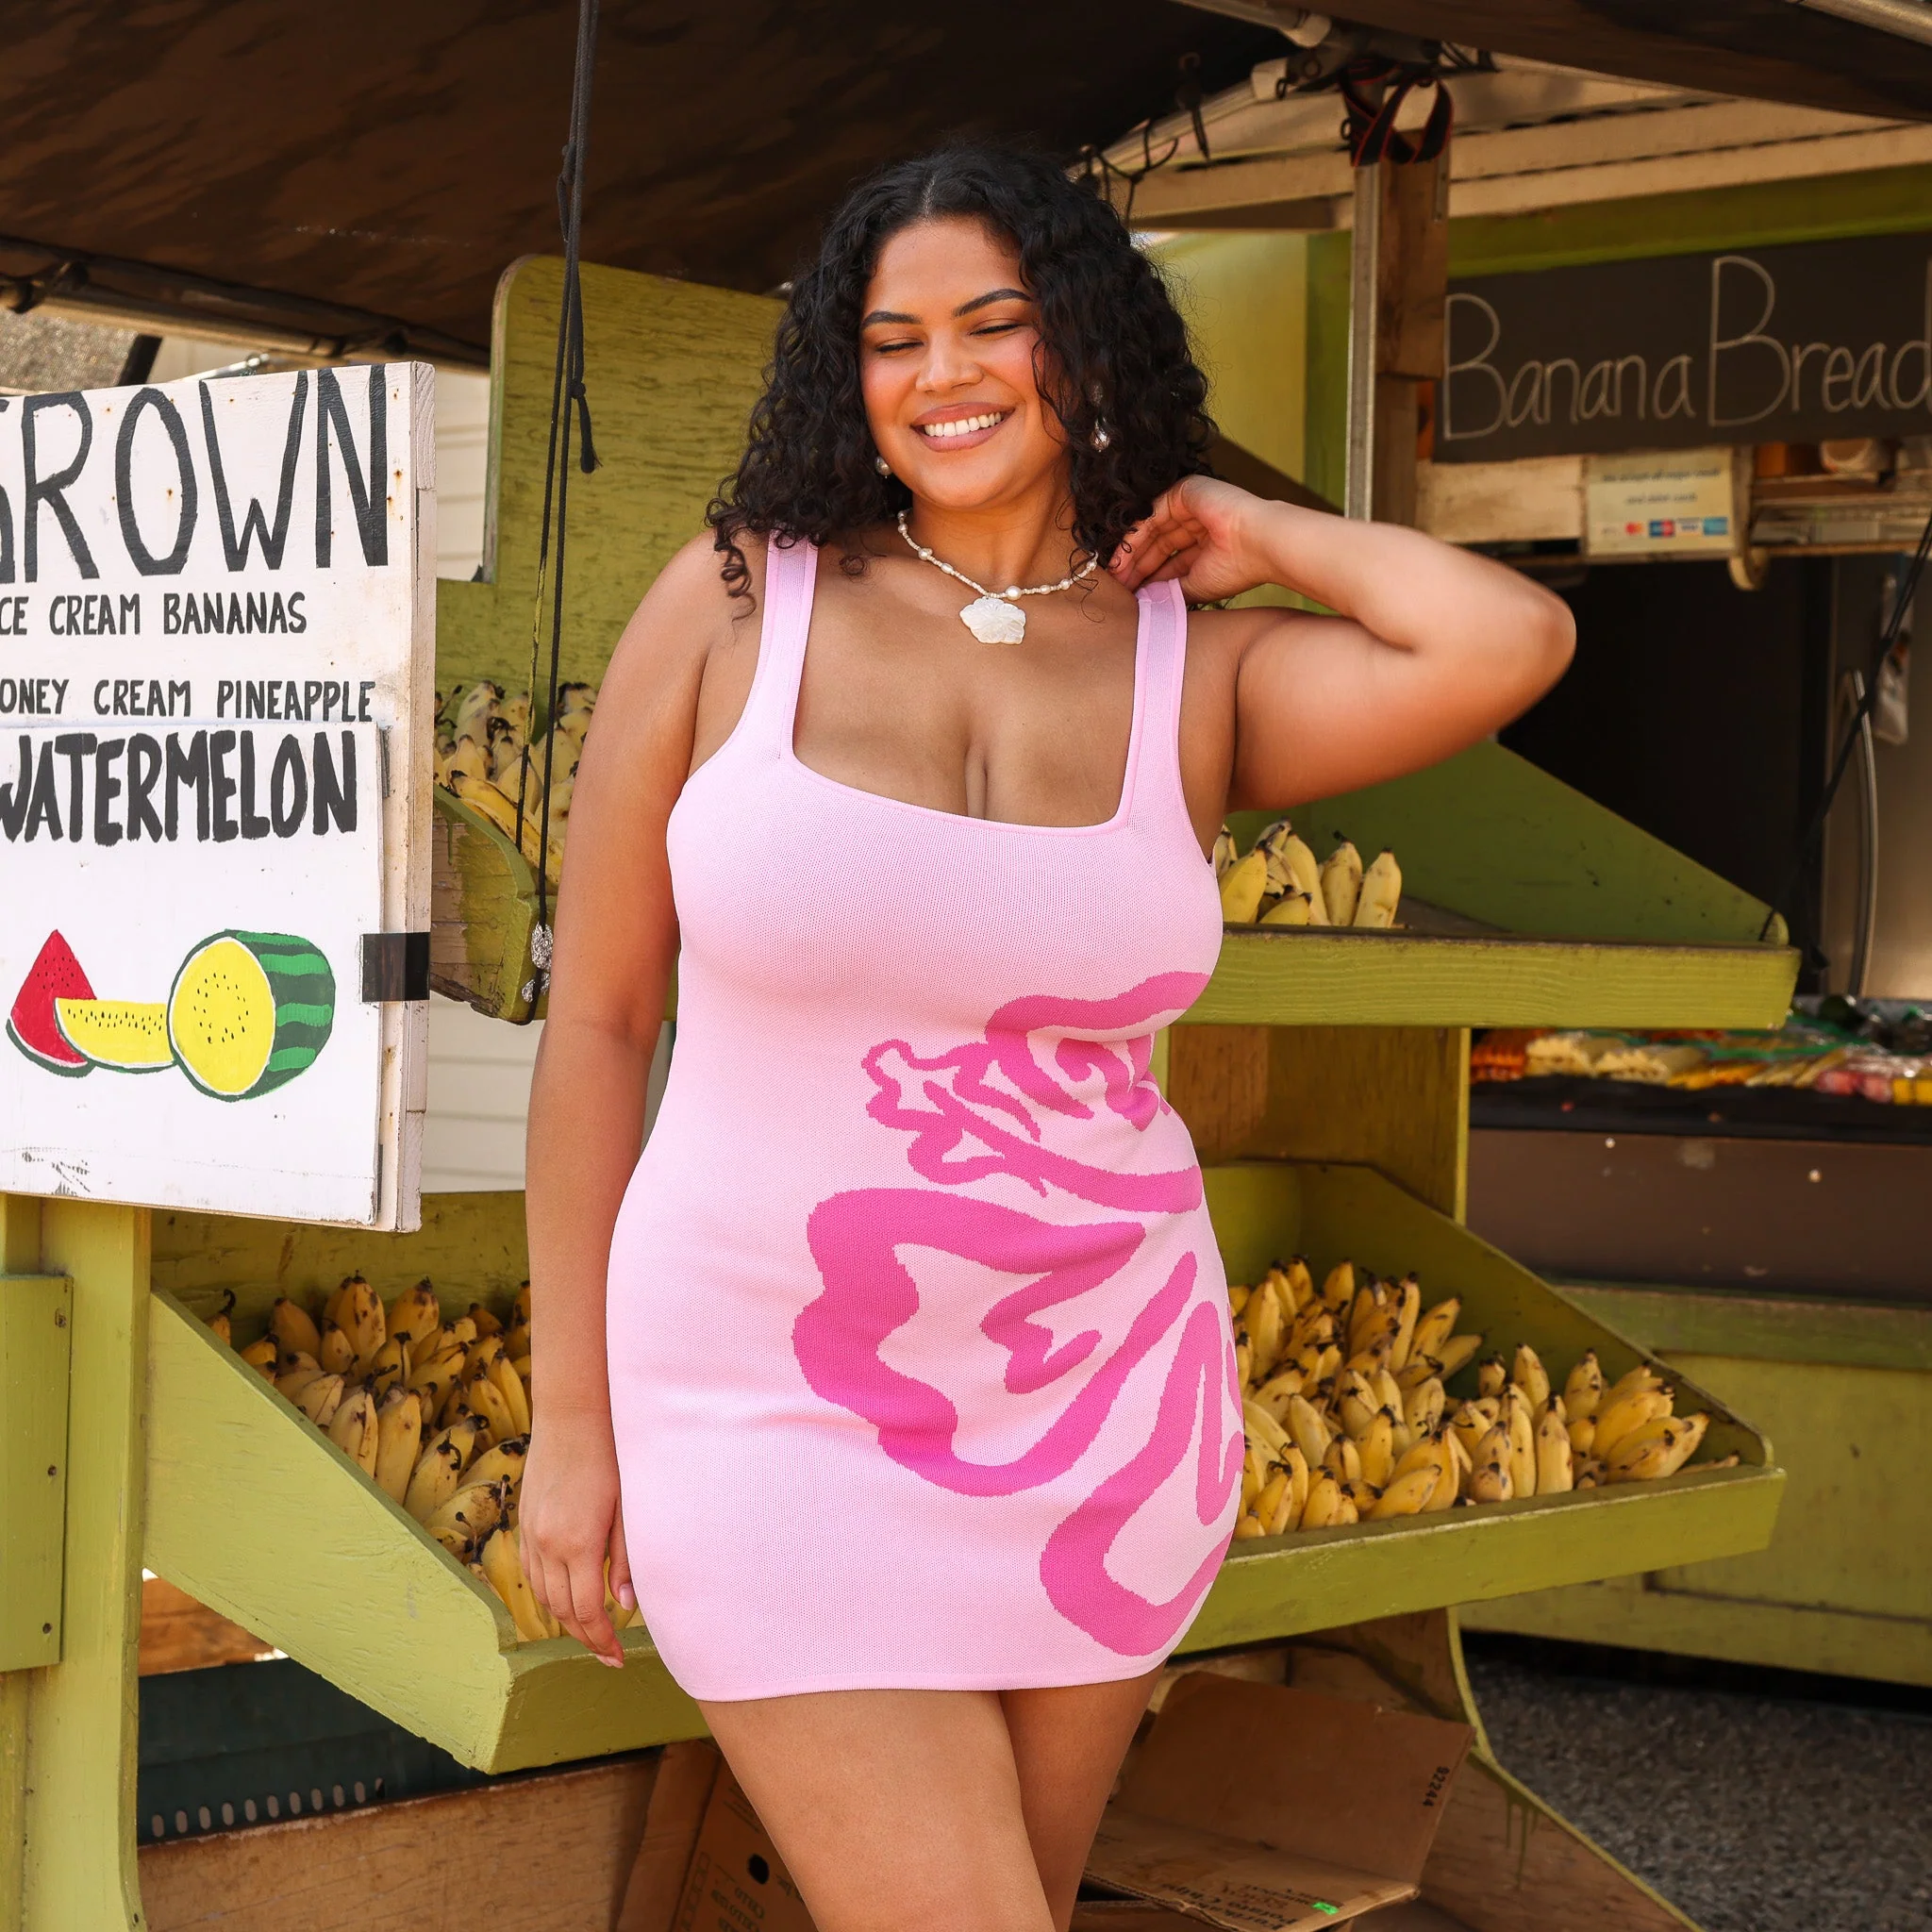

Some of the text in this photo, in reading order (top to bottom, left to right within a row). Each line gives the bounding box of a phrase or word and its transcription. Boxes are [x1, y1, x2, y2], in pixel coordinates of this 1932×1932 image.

[1442, 255, 1932, 441] Banana Bread
[0, 364, 388, 583] ROWN
[49, 591, 141, 636] CREAM
[163, 591, 307, 634] BANANAS
[0, 678, 375, 721] ONEY CREAM PINEAPPLE
